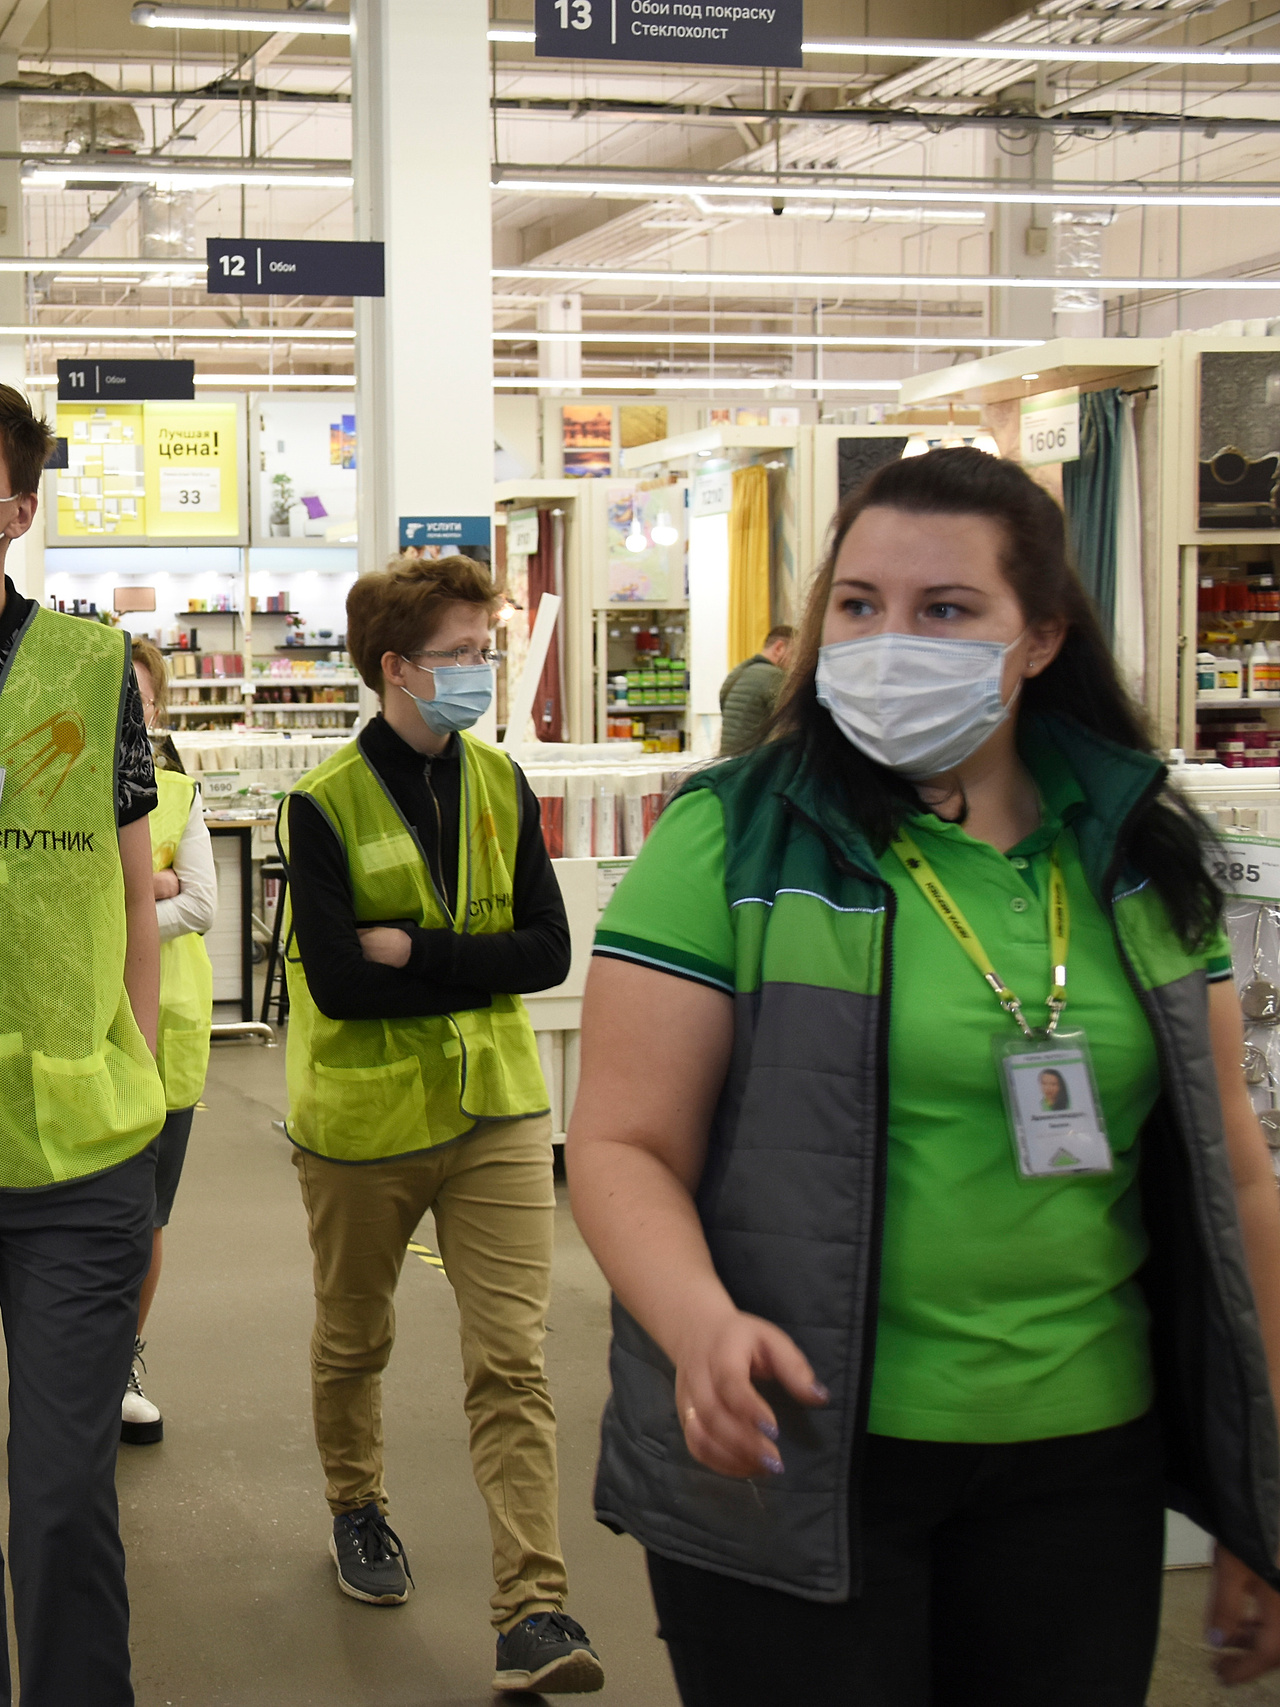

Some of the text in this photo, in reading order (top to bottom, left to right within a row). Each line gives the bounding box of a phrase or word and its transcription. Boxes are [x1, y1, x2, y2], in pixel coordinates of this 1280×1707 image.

[554, 0, 593, 30] 13
[631, 0, 776, 23] Обои под покраску
[631, 21, 729, 40] Стеклохолст
[219, 254, 246, 277] 12
[269, 261, 296, 273] Обои
[68, 371, 85, 388] 11
[105, 375, 127, 384] Обои
[159, 428, 210, 441] Лучшая
[1028, 427, 1067, 453] 1606
[159, 431, 219, 460] цена!
[179, 489, 201, 505] 33
[426, 522, 462, 532] УСЛУГИ
[209, 783, 232, 792] 1690
[1213, 861, 1261, 882] 285
